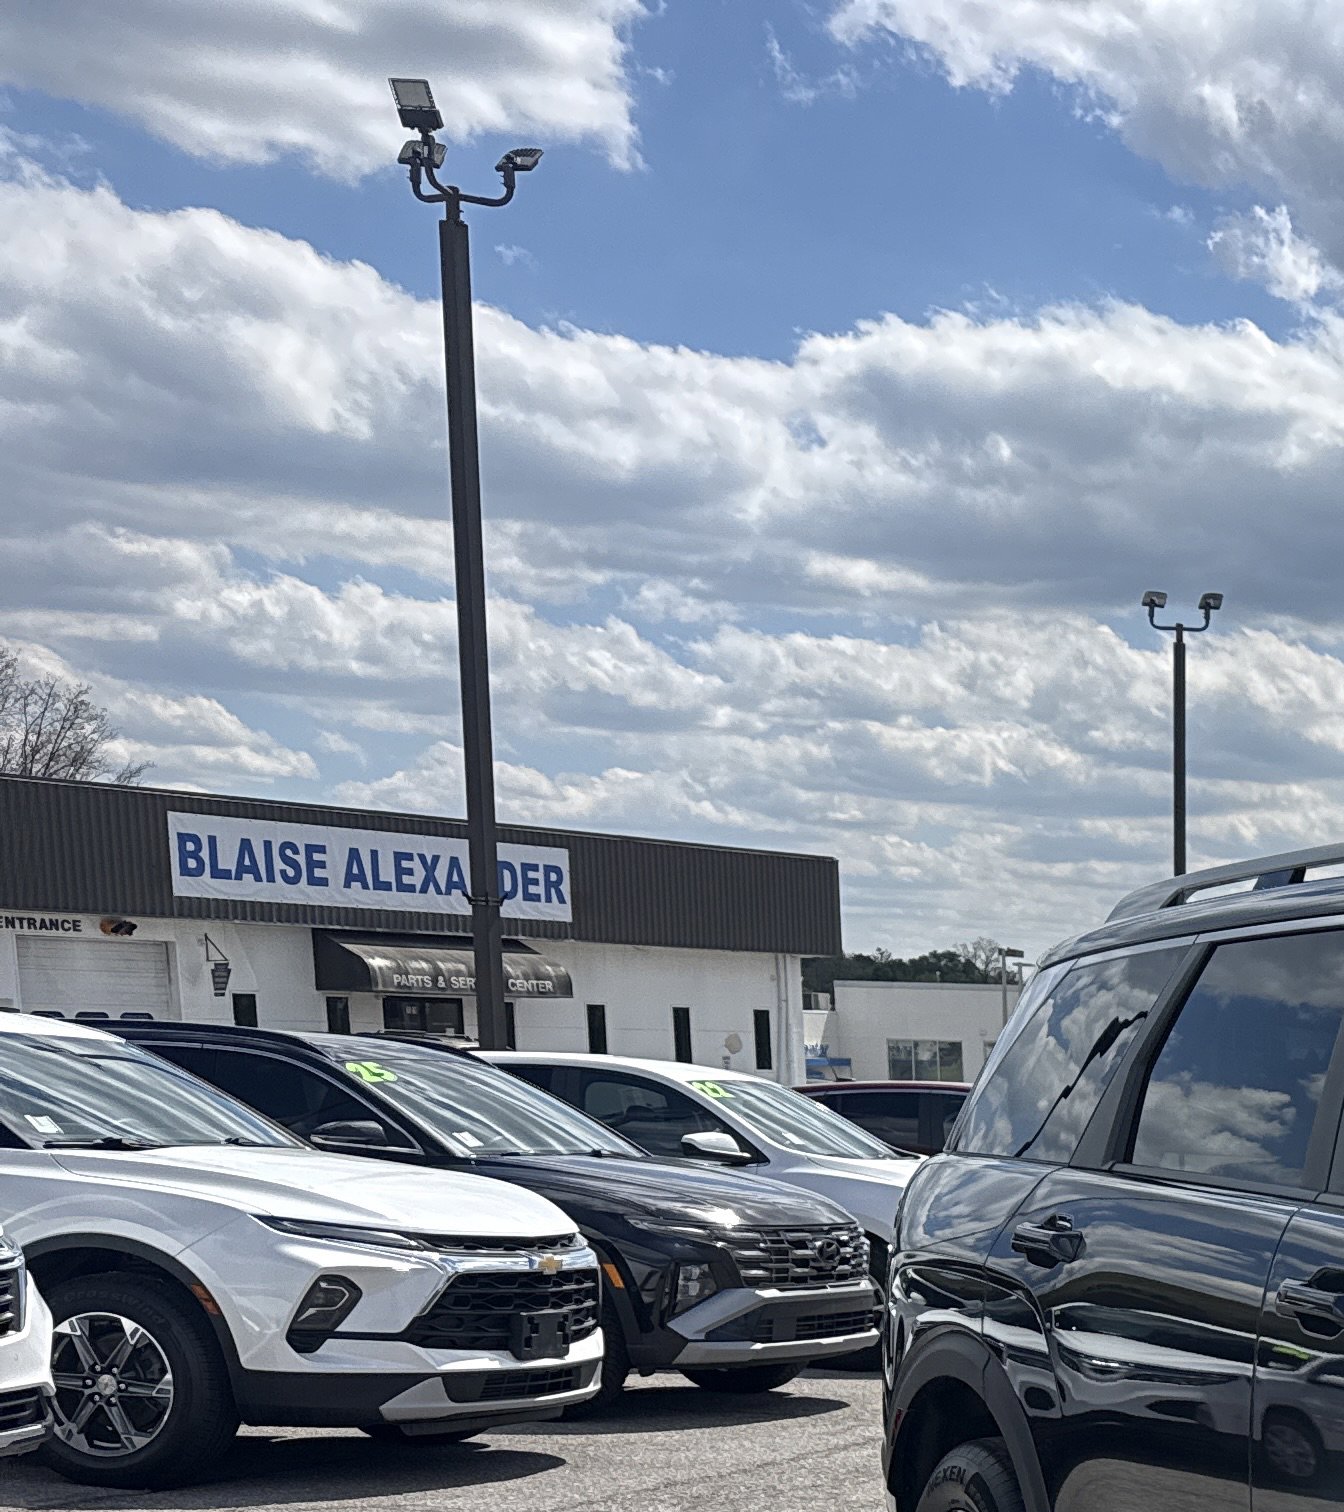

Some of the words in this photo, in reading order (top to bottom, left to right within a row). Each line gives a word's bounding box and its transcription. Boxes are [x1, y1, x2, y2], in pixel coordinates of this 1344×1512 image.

[176, 832, 330, 887] BLAISE
[343, 847, 567, 904] ALEXADER
[0, 915, 82, 932] NTRANCE
[393, 974, 433, 988] PARTS
[437, 975, 447, 988] &
[508, 978, 554, 992] CENTER
[345, 1061, 398, 1083] 25
